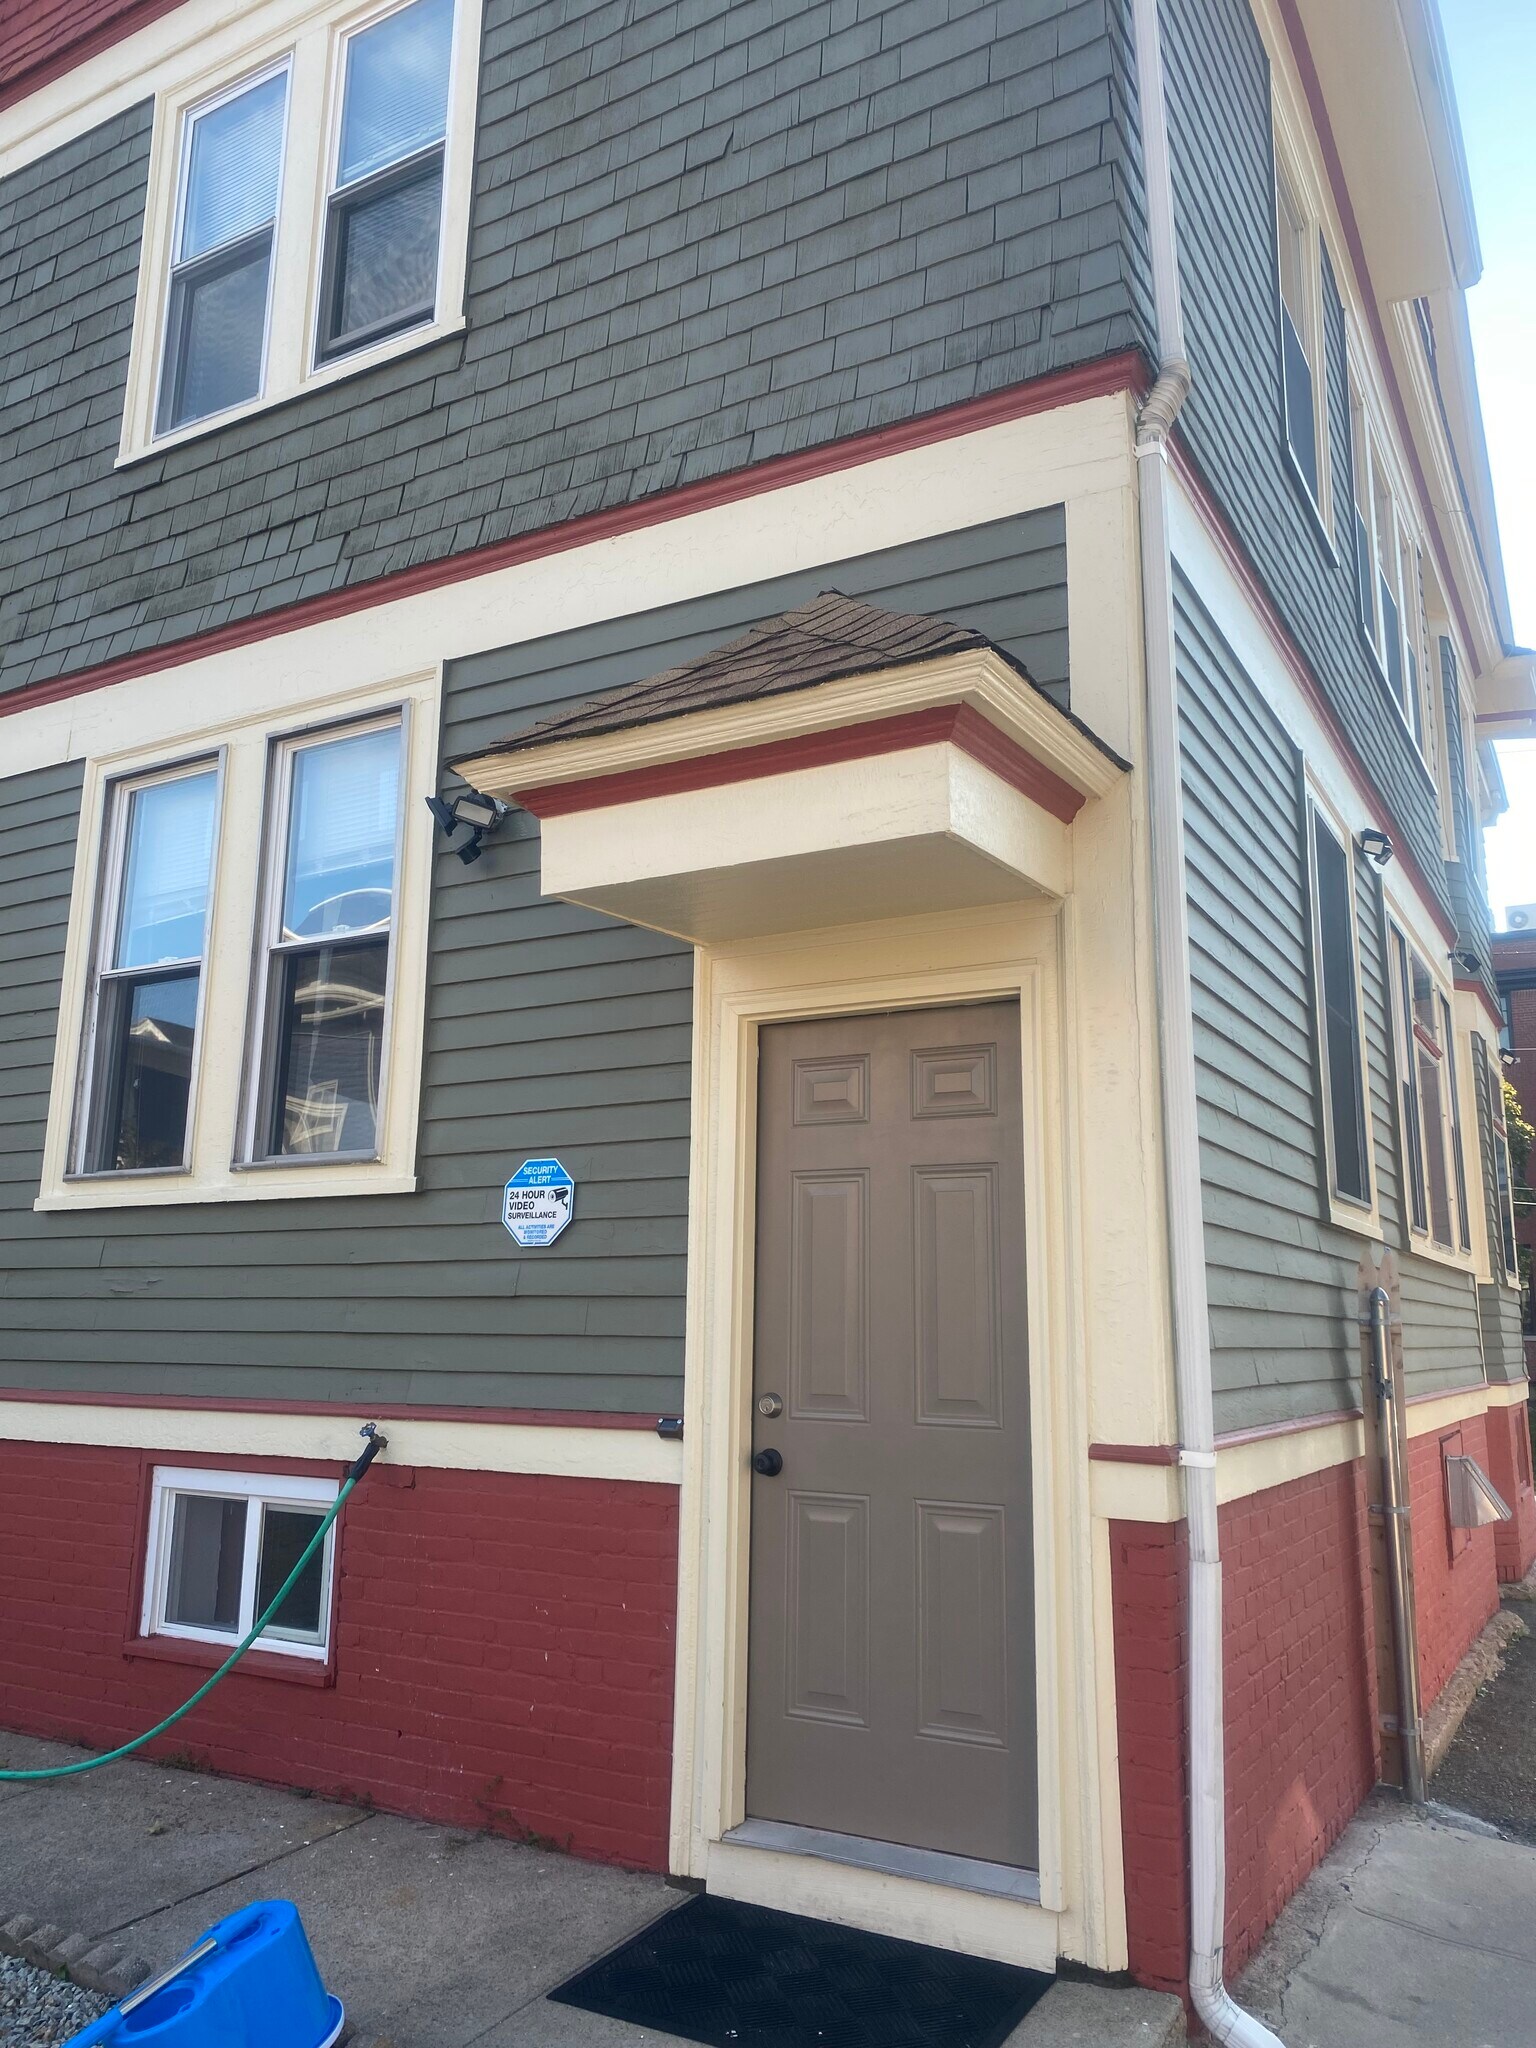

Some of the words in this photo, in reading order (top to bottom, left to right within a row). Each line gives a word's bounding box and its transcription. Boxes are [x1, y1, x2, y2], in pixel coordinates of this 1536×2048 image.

[523, 1165, 558, 1175] SECURITY
[528, 1176, 552, 1184] ALERT
[509, 1191, 519, 1200] 24
[522, 1190, 545, 1199] HOUR
[509, 1201, 535, 1210] VIDEO
[507, 1211, 557, 1219] SURVEILLANCE
